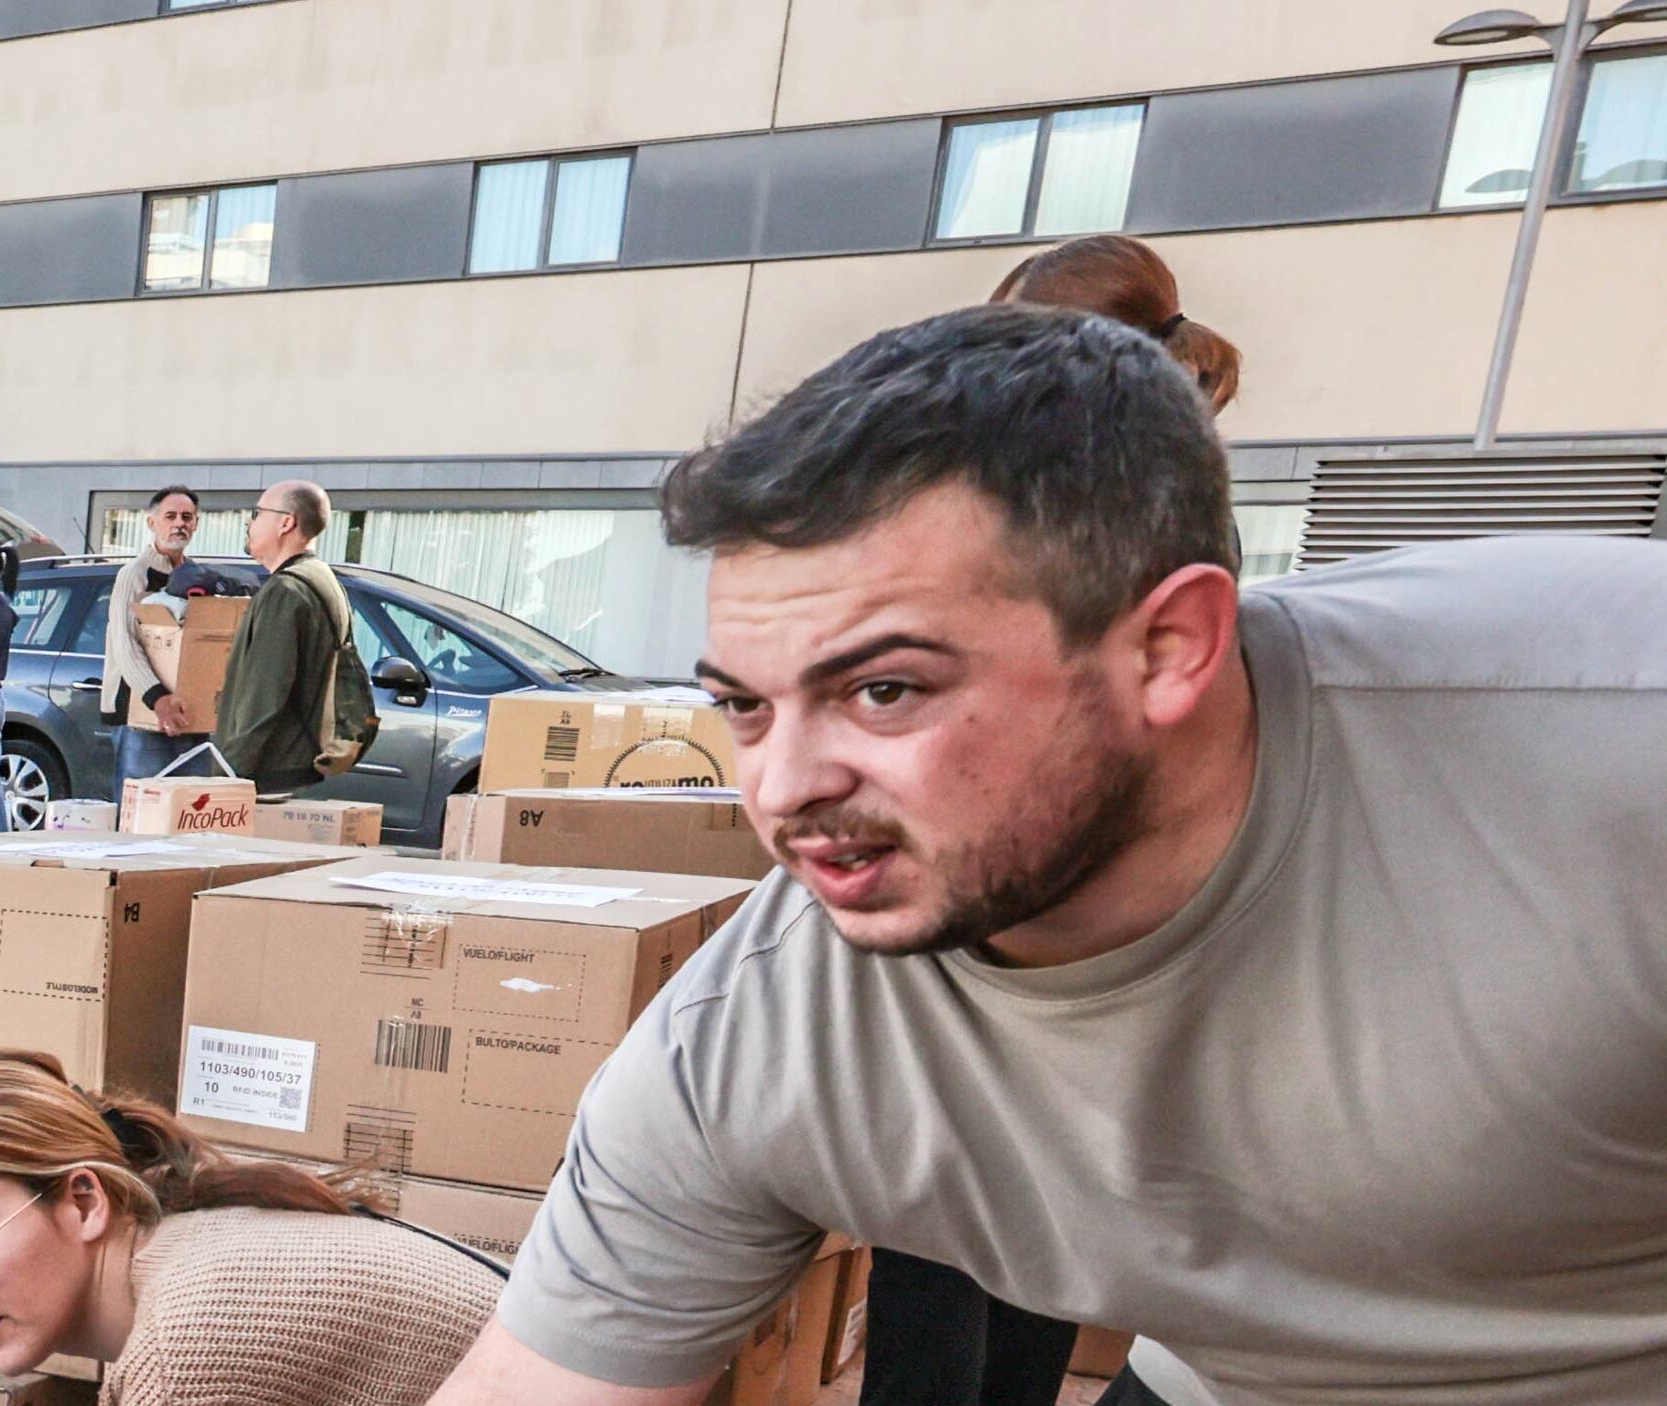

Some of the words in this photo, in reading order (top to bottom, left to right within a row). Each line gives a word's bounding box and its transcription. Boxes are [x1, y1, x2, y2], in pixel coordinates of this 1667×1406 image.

[177, 802, 249, 830] IncoPack
[519, 809, 545, 827] A8
[123, 902, 140, 923] B4
[463, 946, 536, 964] VUELO/FLIGHT
[475, 1036, 562, 1056] BULTO/PACKAGE
[199, 1061, 302, 1085] 1103/490/105/37
[204, 1081, 220, 1093] 10
